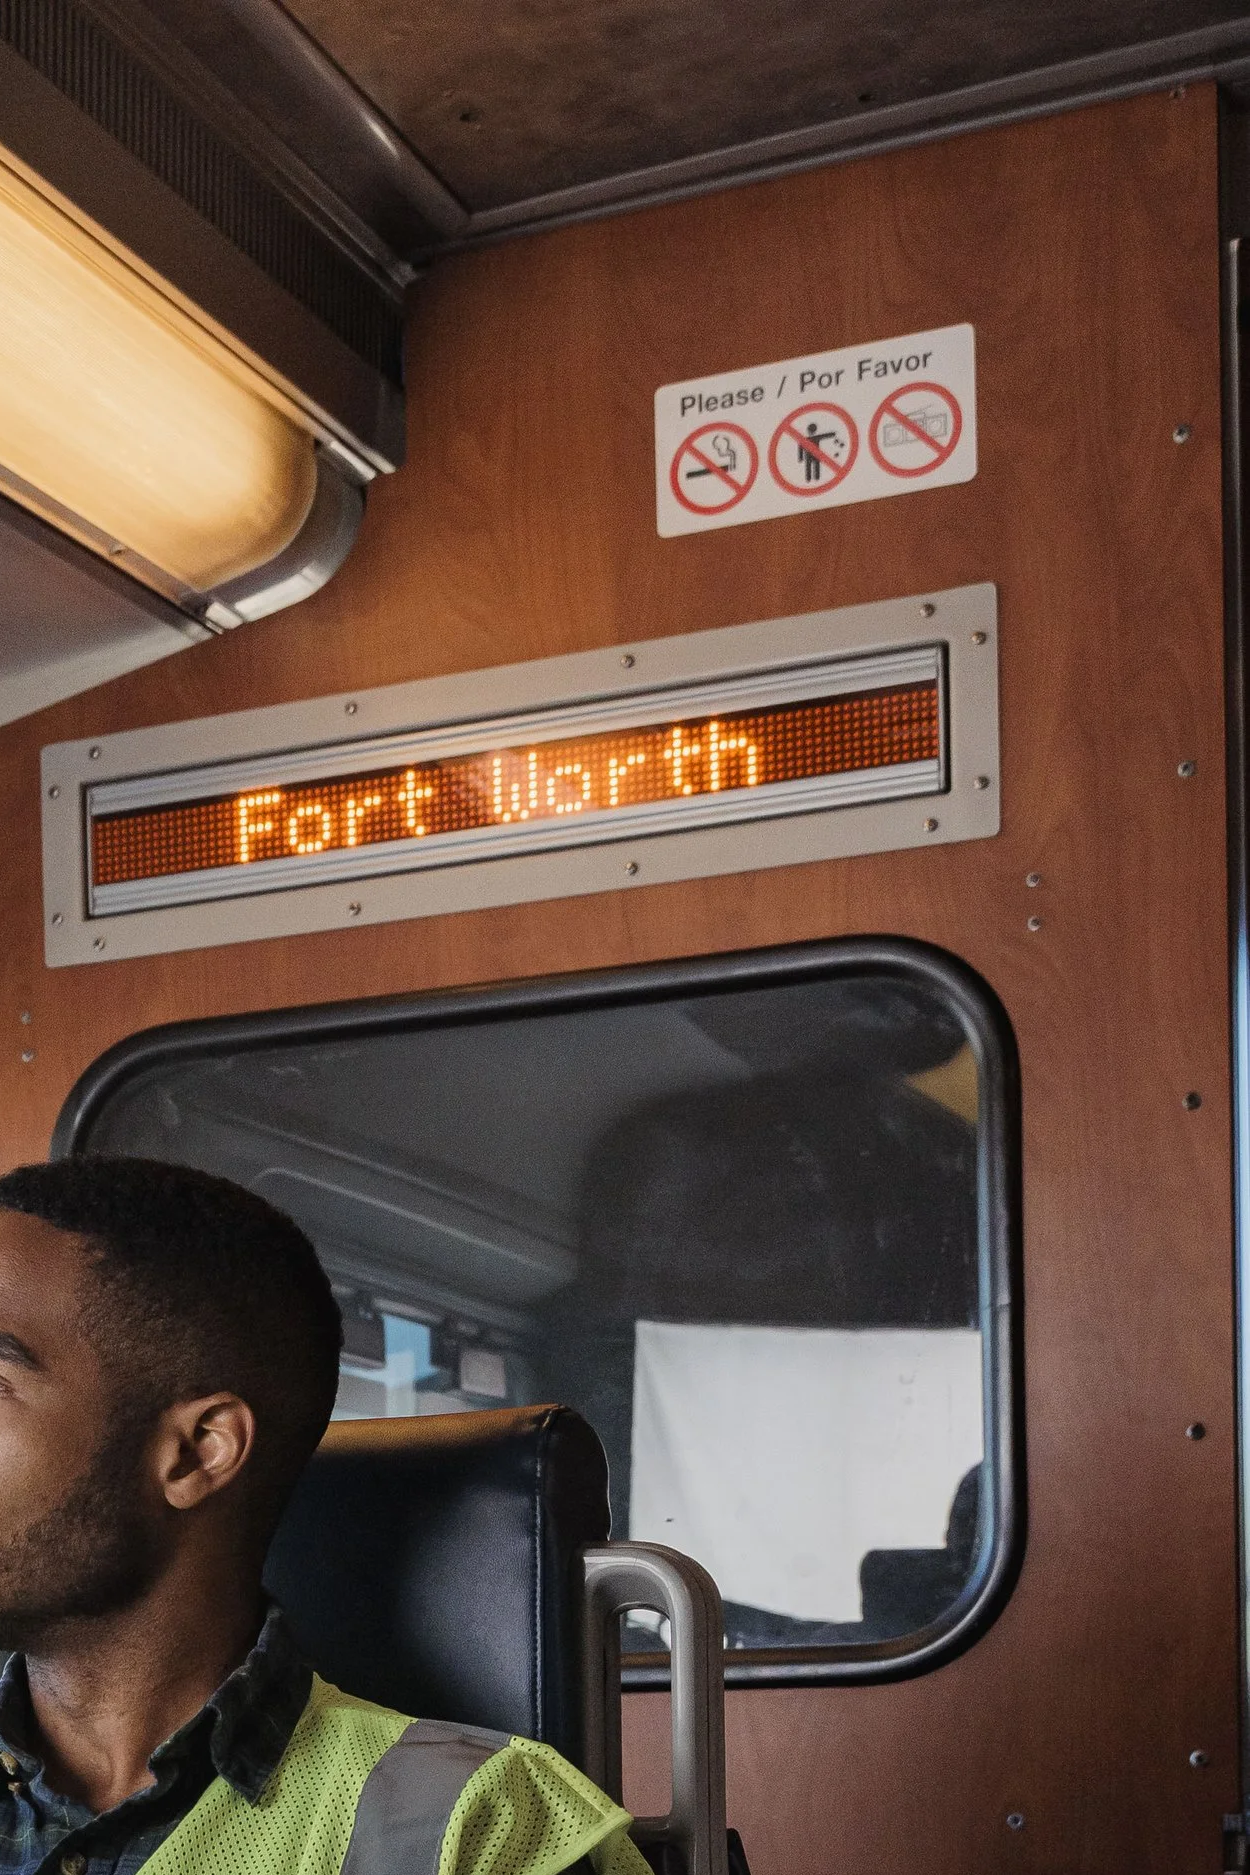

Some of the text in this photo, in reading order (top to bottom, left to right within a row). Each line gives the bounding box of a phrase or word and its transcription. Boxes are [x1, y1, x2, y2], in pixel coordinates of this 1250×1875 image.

[680, 350, 933, 417] Please / Por Favor
[238, 721, 758, 864] Fort Worth
